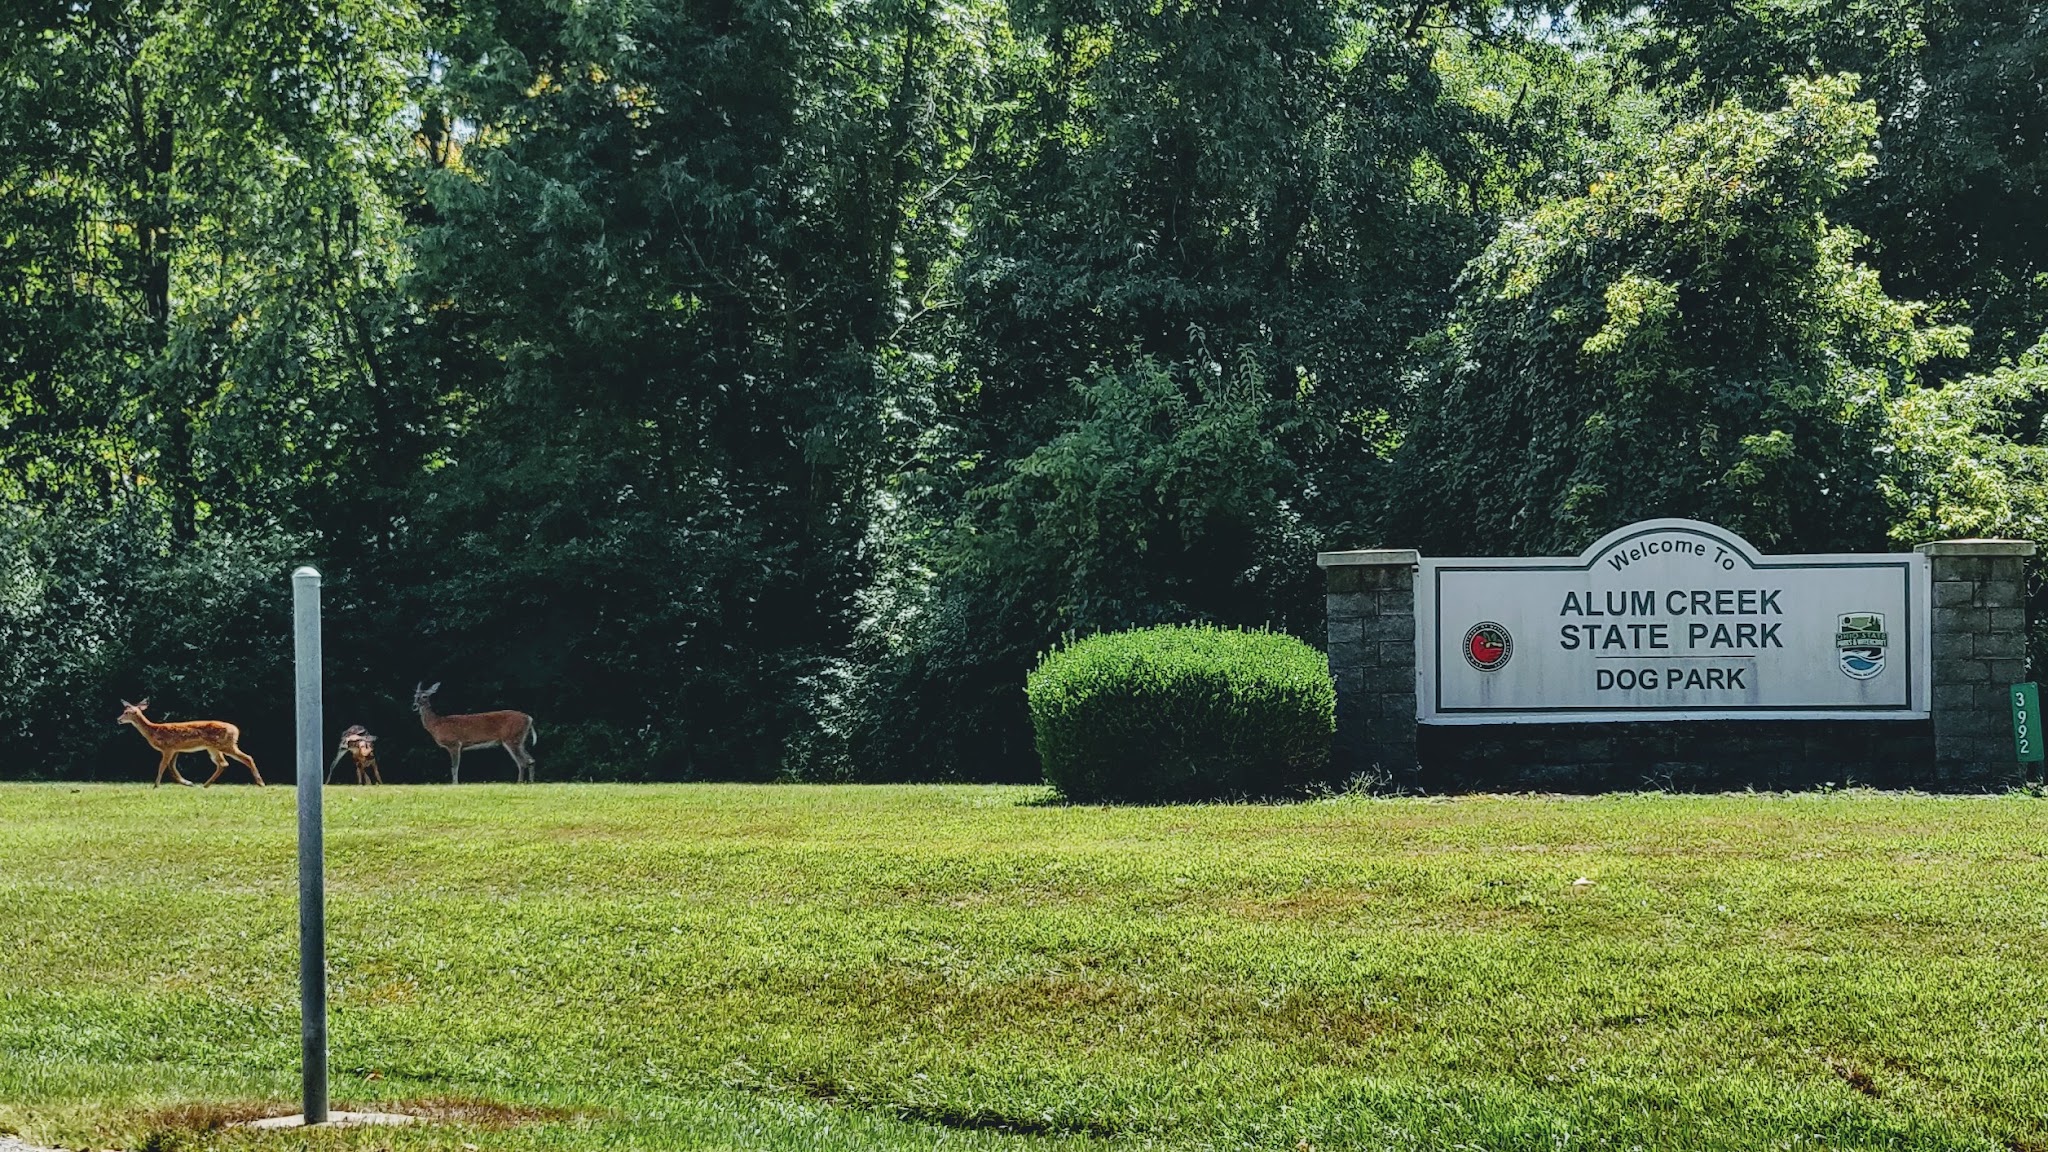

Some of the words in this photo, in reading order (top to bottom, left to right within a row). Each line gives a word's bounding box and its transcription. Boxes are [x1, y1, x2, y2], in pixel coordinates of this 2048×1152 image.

[1607, 539, 1706, 572] Welcome
[1714, 547, 1735, 571] To
[1560, 591, 1655, 616] ALUM
[1666, 590, 1783, 616] CREEK
[1560, 624, 1669, 650] STATE
[1689, 623, 1783, 649] PARK
[1597, 669, 1658, 690] DOG
[1667, 668, 1746, 690] PARK
[2015, 692, 2029, 754] 3992
